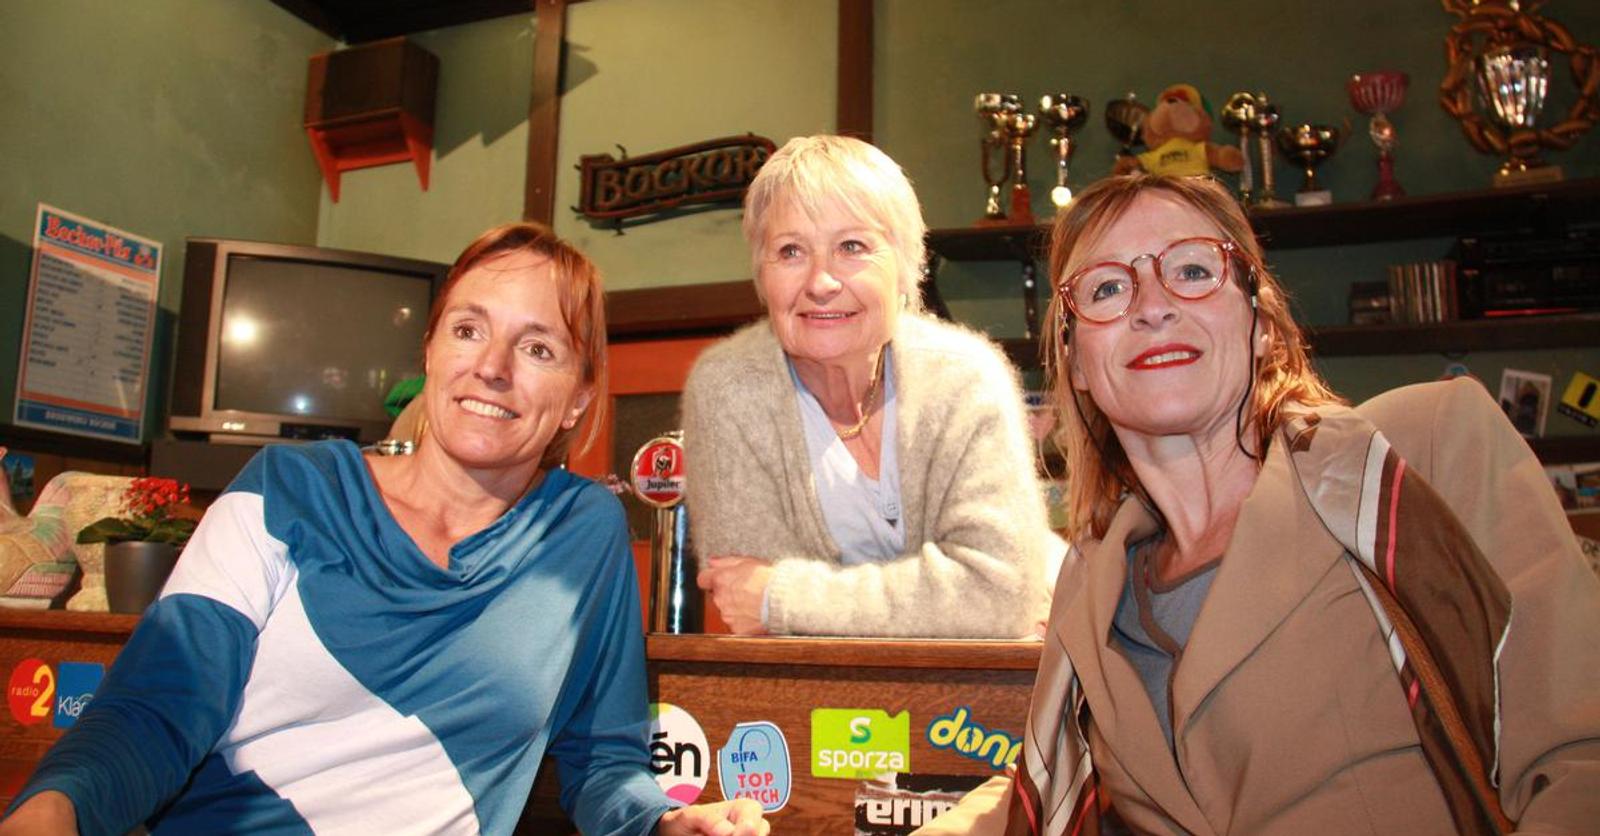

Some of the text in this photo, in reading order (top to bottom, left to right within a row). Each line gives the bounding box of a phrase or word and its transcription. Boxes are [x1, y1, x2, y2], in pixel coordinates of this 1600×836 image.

[597, 149, 761, 209] BOCKOR
[11, 664, 55, 717] radio 2
[649, 732, 701, 777] én
[731, 752, 758, 764] BIFA
[818, 749, 904, 772] sporza
[737, 772, 774, 788] TOP
